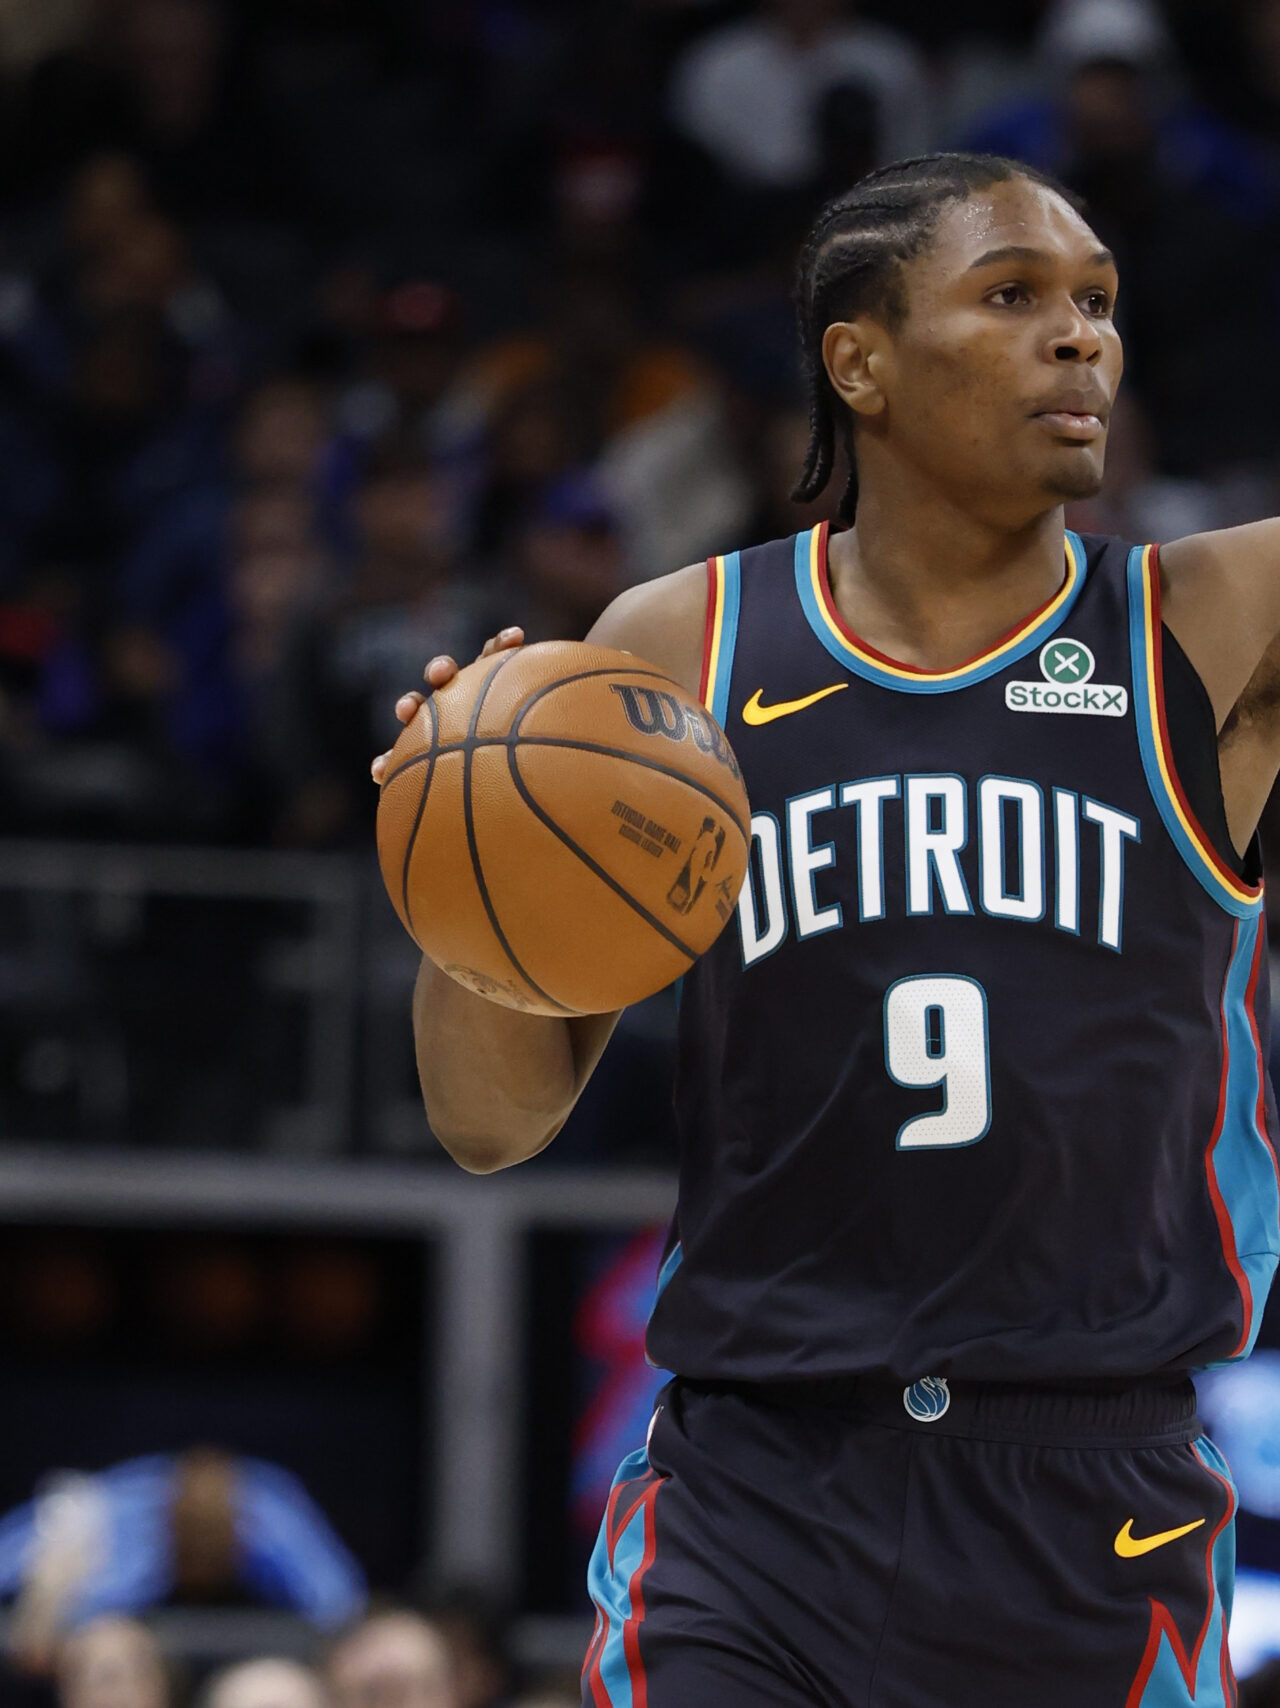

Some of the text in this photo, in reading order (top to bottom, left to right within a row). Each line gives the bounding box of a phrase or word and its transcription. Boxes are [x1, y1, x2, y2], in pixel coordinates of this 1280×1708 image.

[1010, 685, 1123, 712] StockX
[737, 773, 1142, 972] DETROIT
[883, 973, 992, 1151] 9
